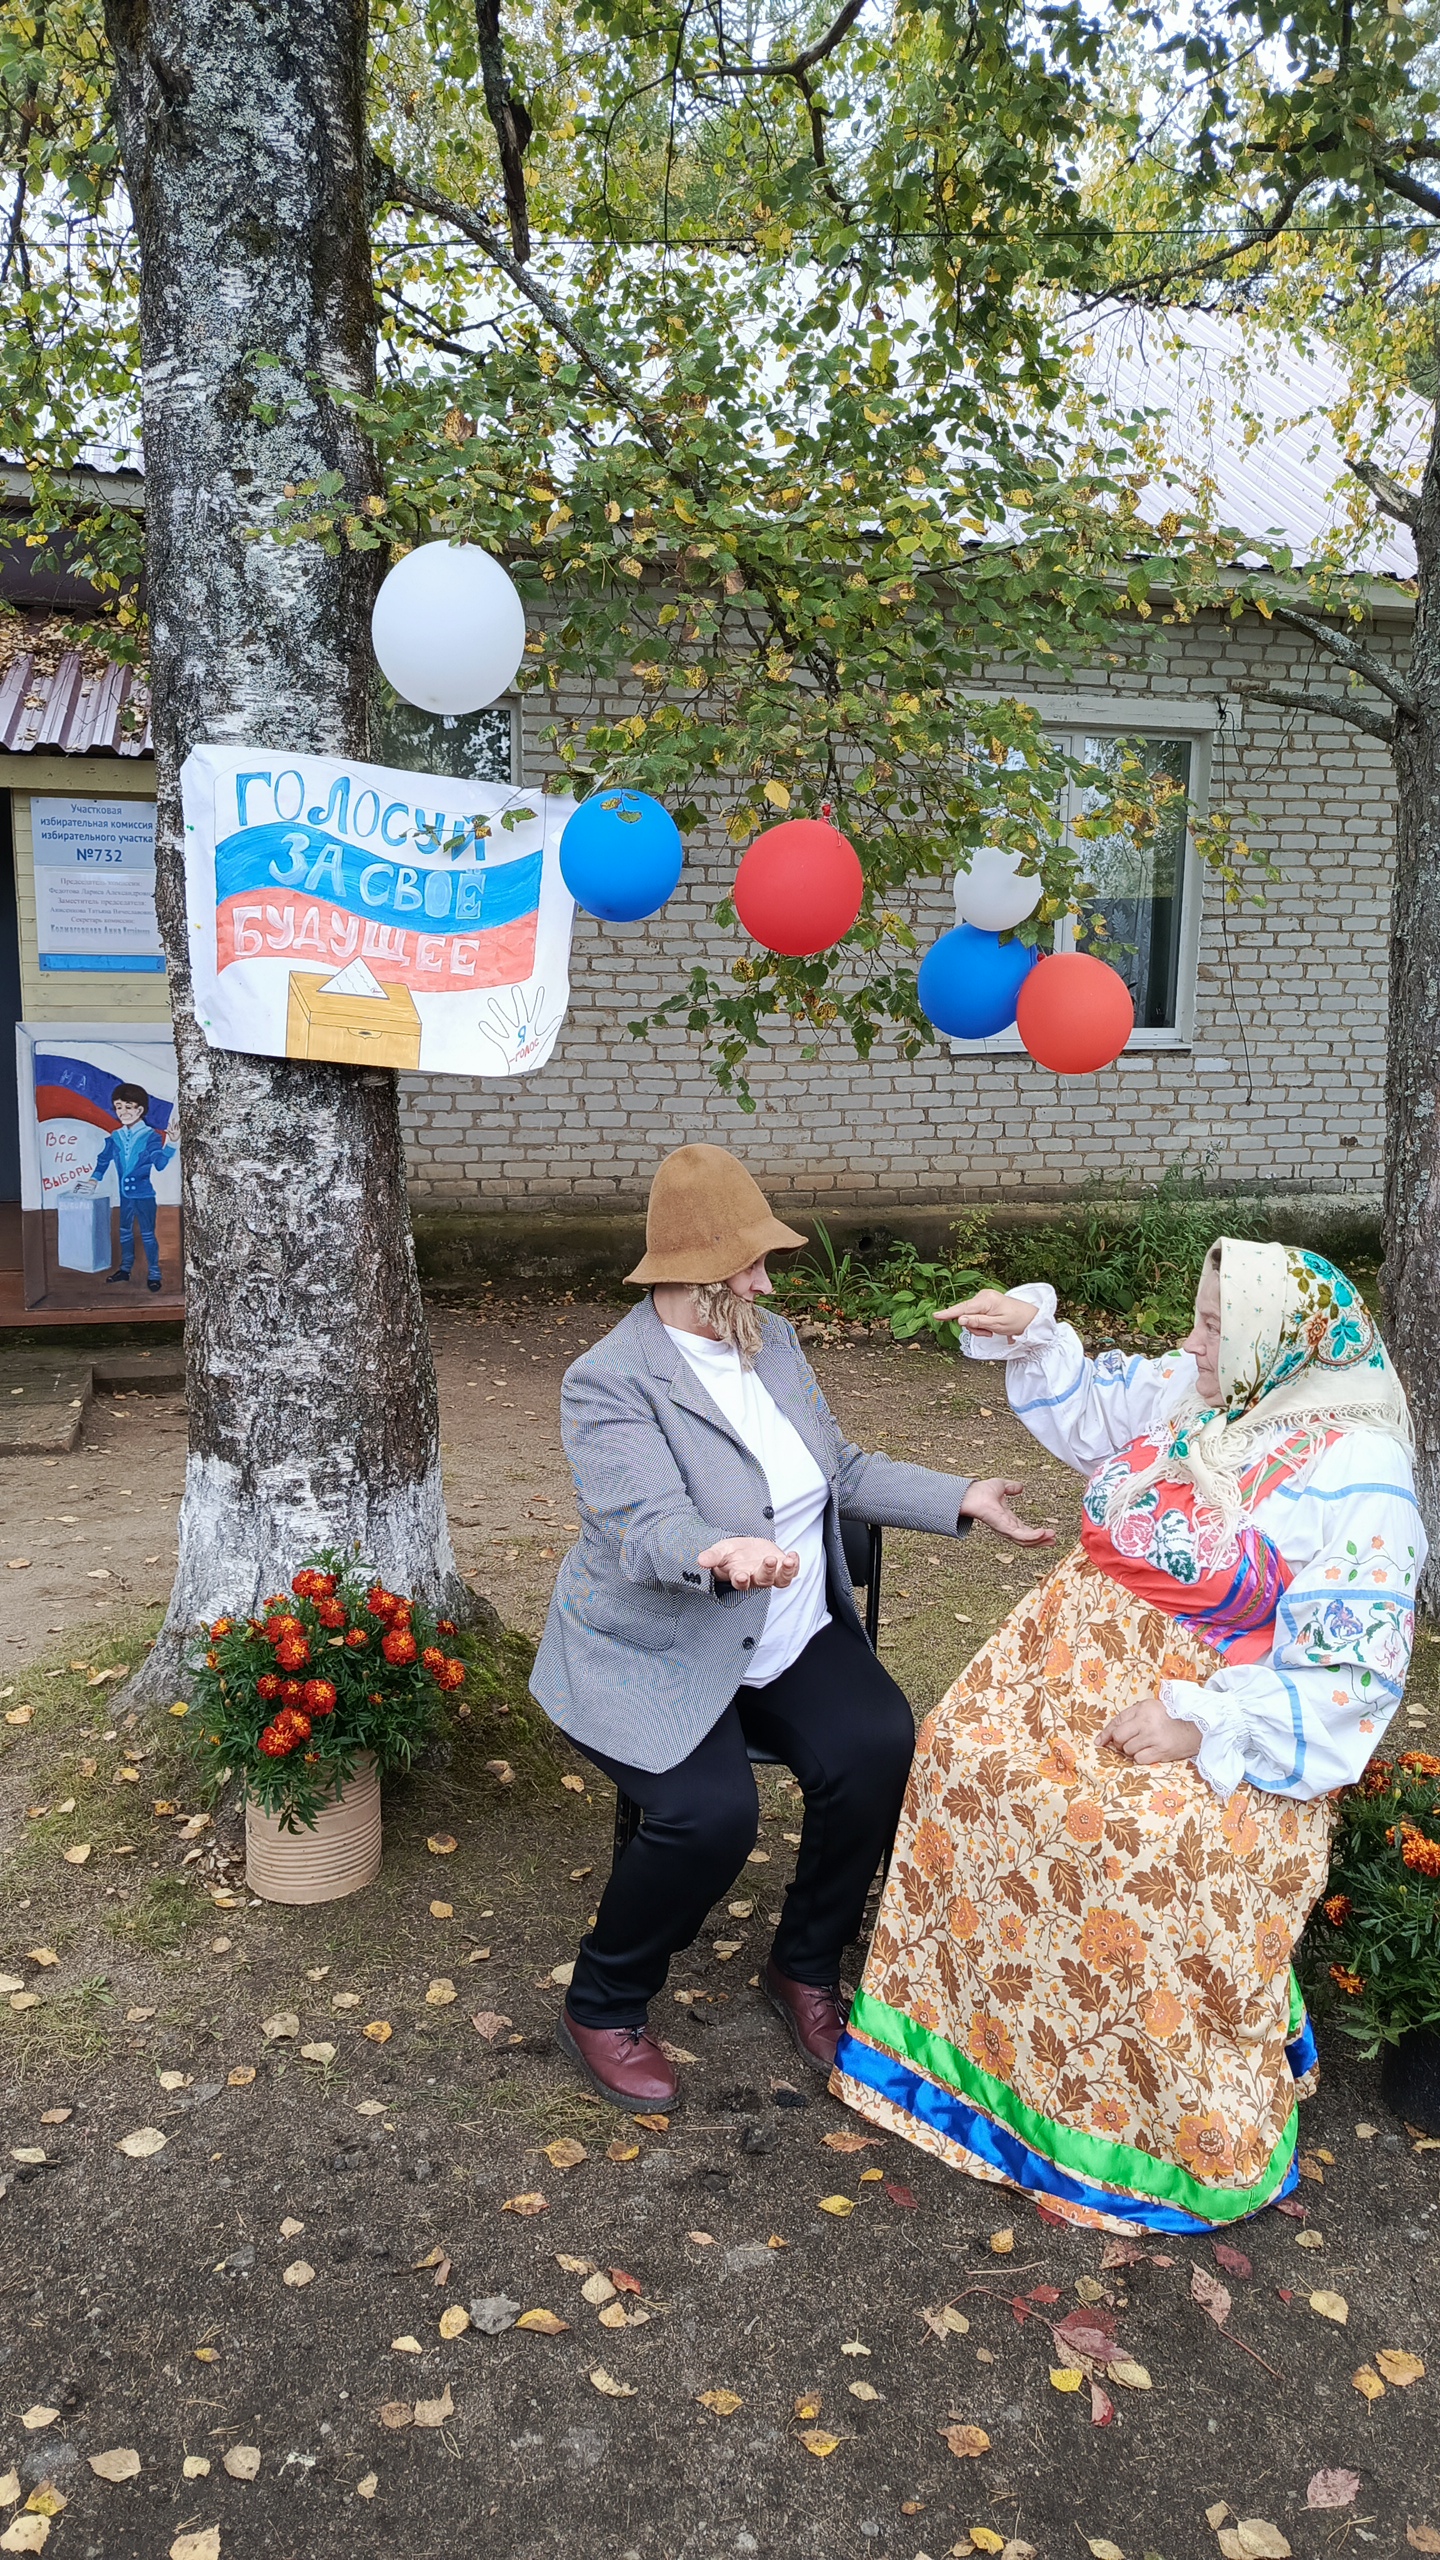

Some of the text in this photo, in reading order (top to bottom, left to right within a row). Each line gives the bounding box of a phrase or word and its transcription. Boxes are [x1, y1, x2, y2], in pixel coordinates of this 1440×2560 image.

[70, 803, 122, 815] Участковая
[236, 770, 487, 861] ГОЛОСУЙ
[40, 817, 153, 829] избирательная комиссия
[41, 831, 153, 844] избирательного участка
[76, 848, 122, 862] №732
[269, 832, 486, 919] ЗА СВОЁ
[232, 905, 480, 976] БУДУЩЕЕ
[516, 1025, 527, 1048] Я
[45, 1131, 78, 1147] Все
[42, 1163, 93, 1191] ВЫБОРЫ
